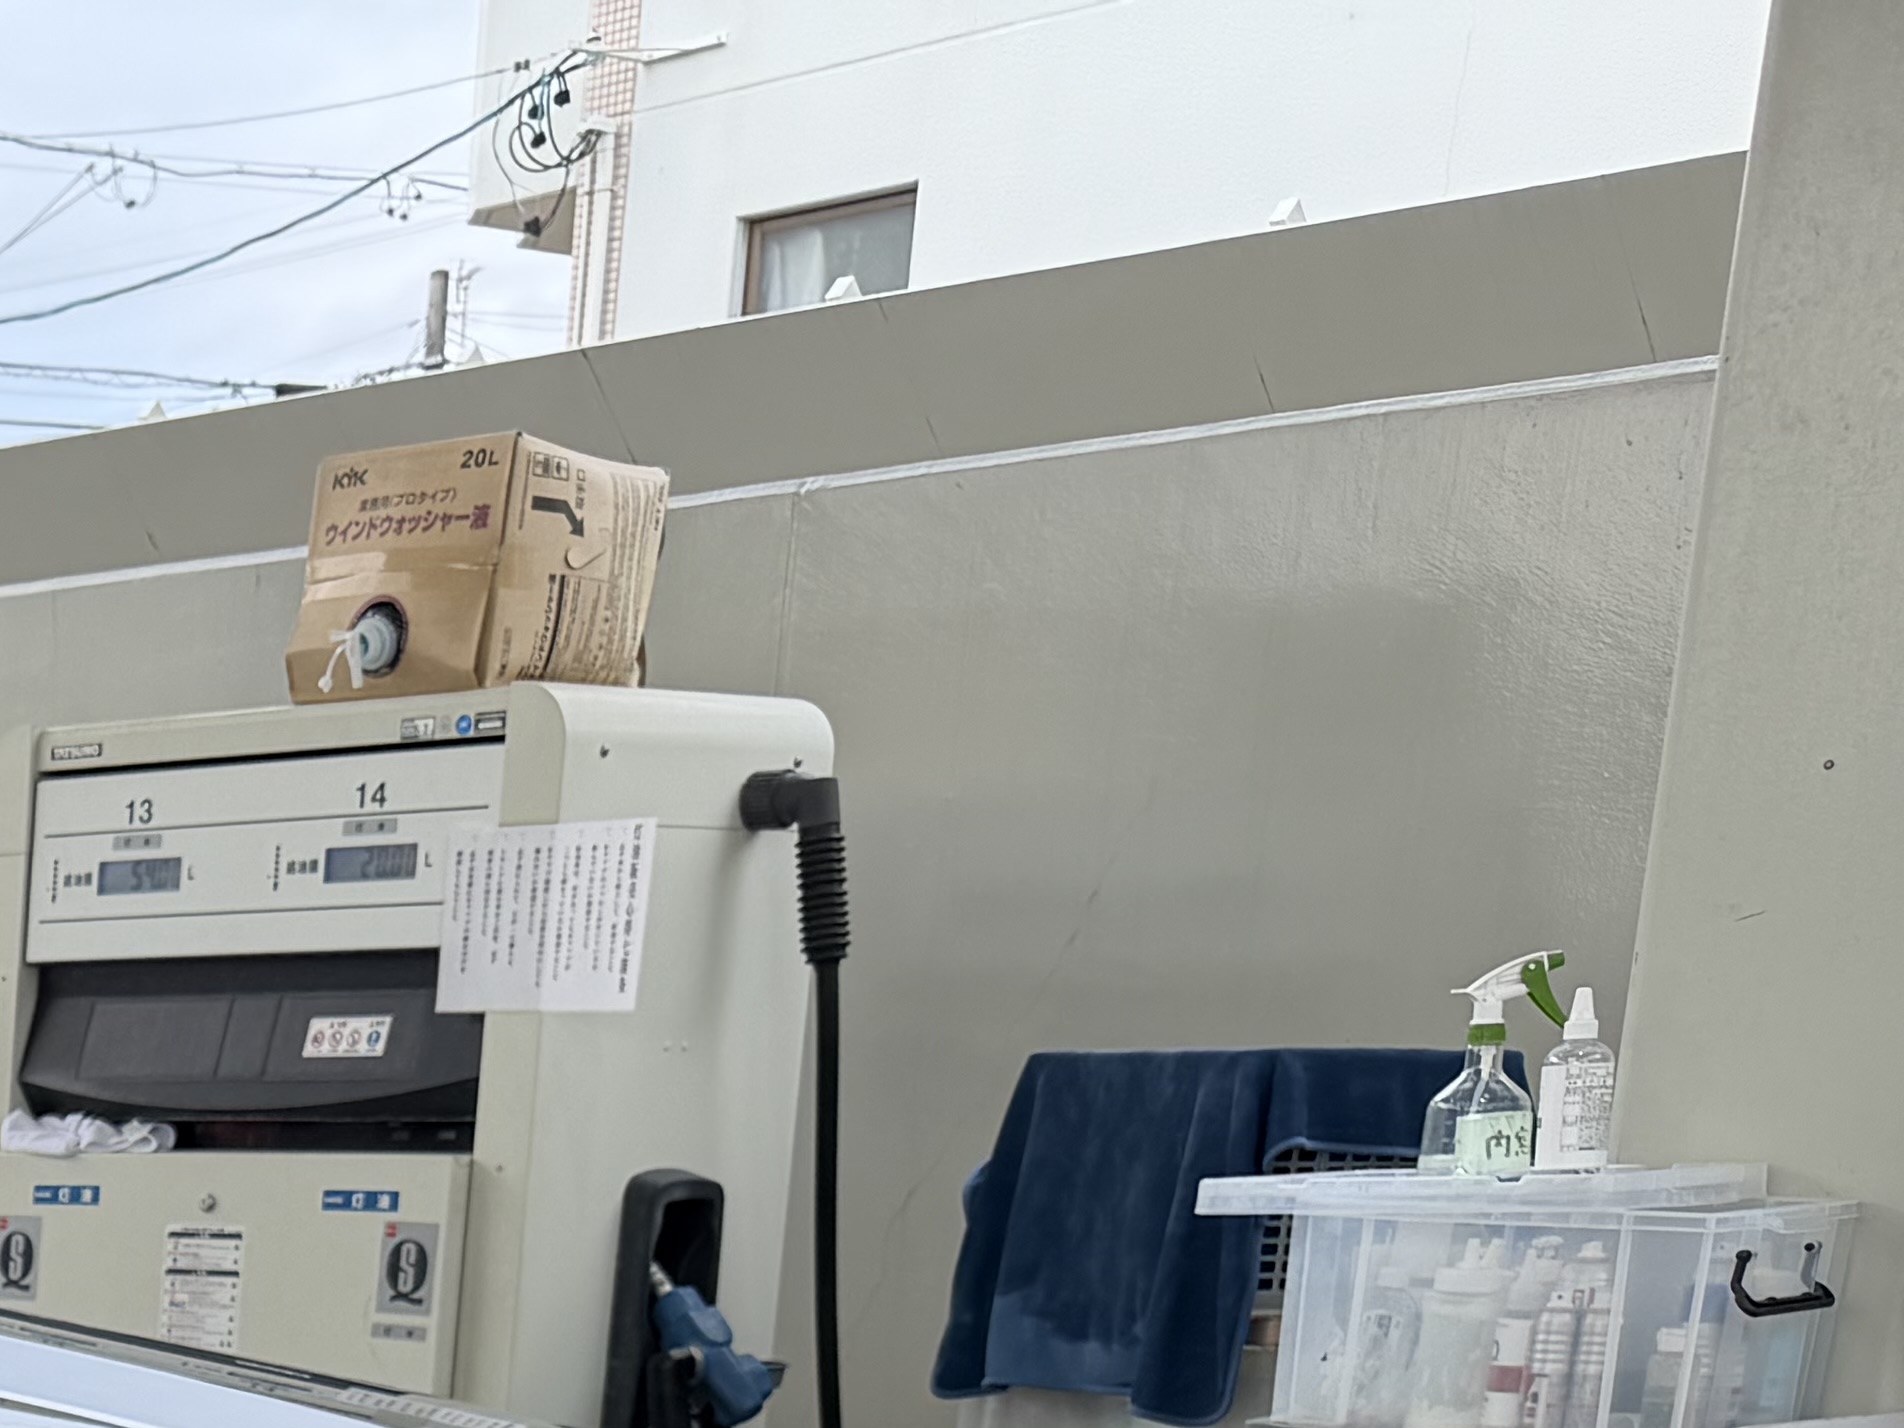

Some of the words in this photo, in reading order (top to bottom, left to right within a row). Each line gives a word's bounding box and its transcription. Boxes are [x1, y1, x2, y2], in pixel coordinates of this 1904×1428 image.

[460, 448, 500, 469] 20L
[355, 781, 388, 809] 14
[125, 798, 153, 825] 13
